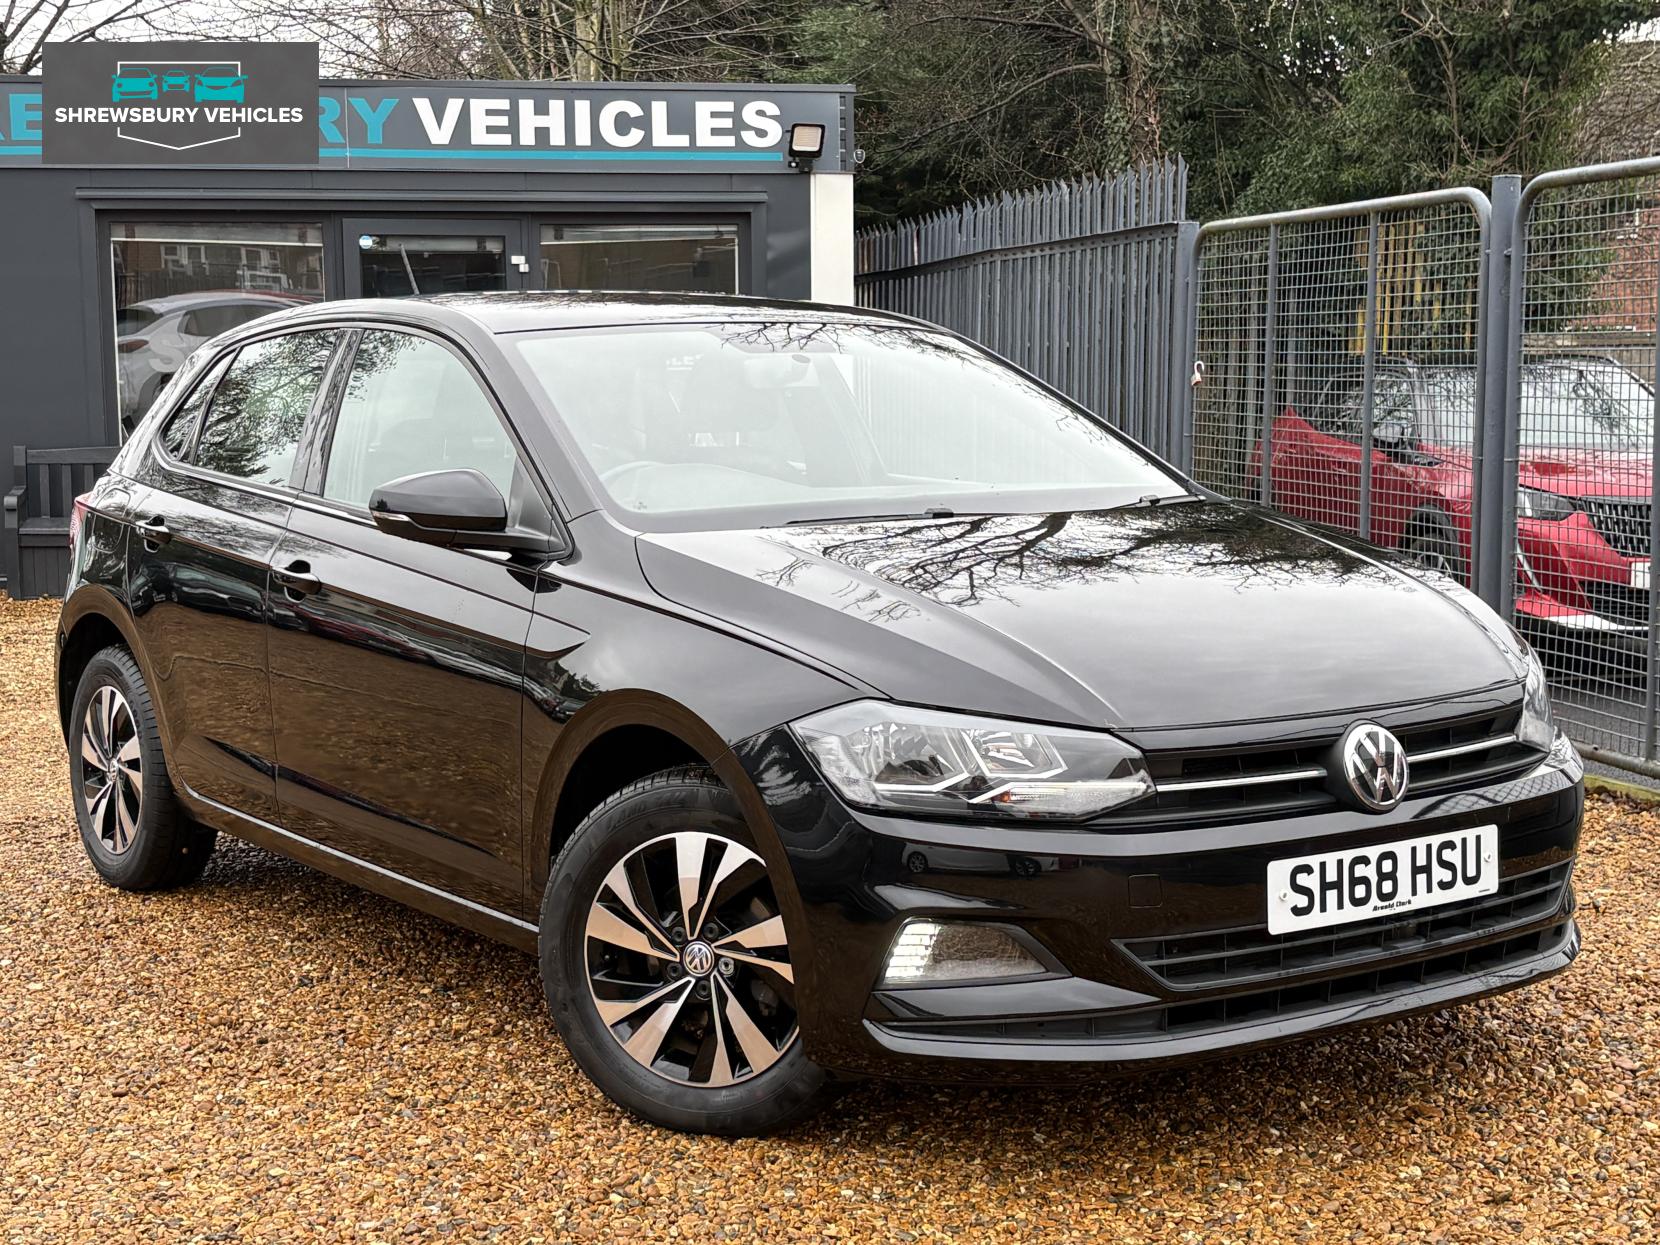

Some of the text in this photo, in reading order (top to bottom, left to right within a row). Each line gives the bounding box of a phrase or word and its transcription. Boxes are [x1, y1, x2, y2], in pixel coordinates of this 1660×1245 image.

[412, 98, 783, 148] VEHICLES
[1289, 834, 1482, 917] SH68 HSU
